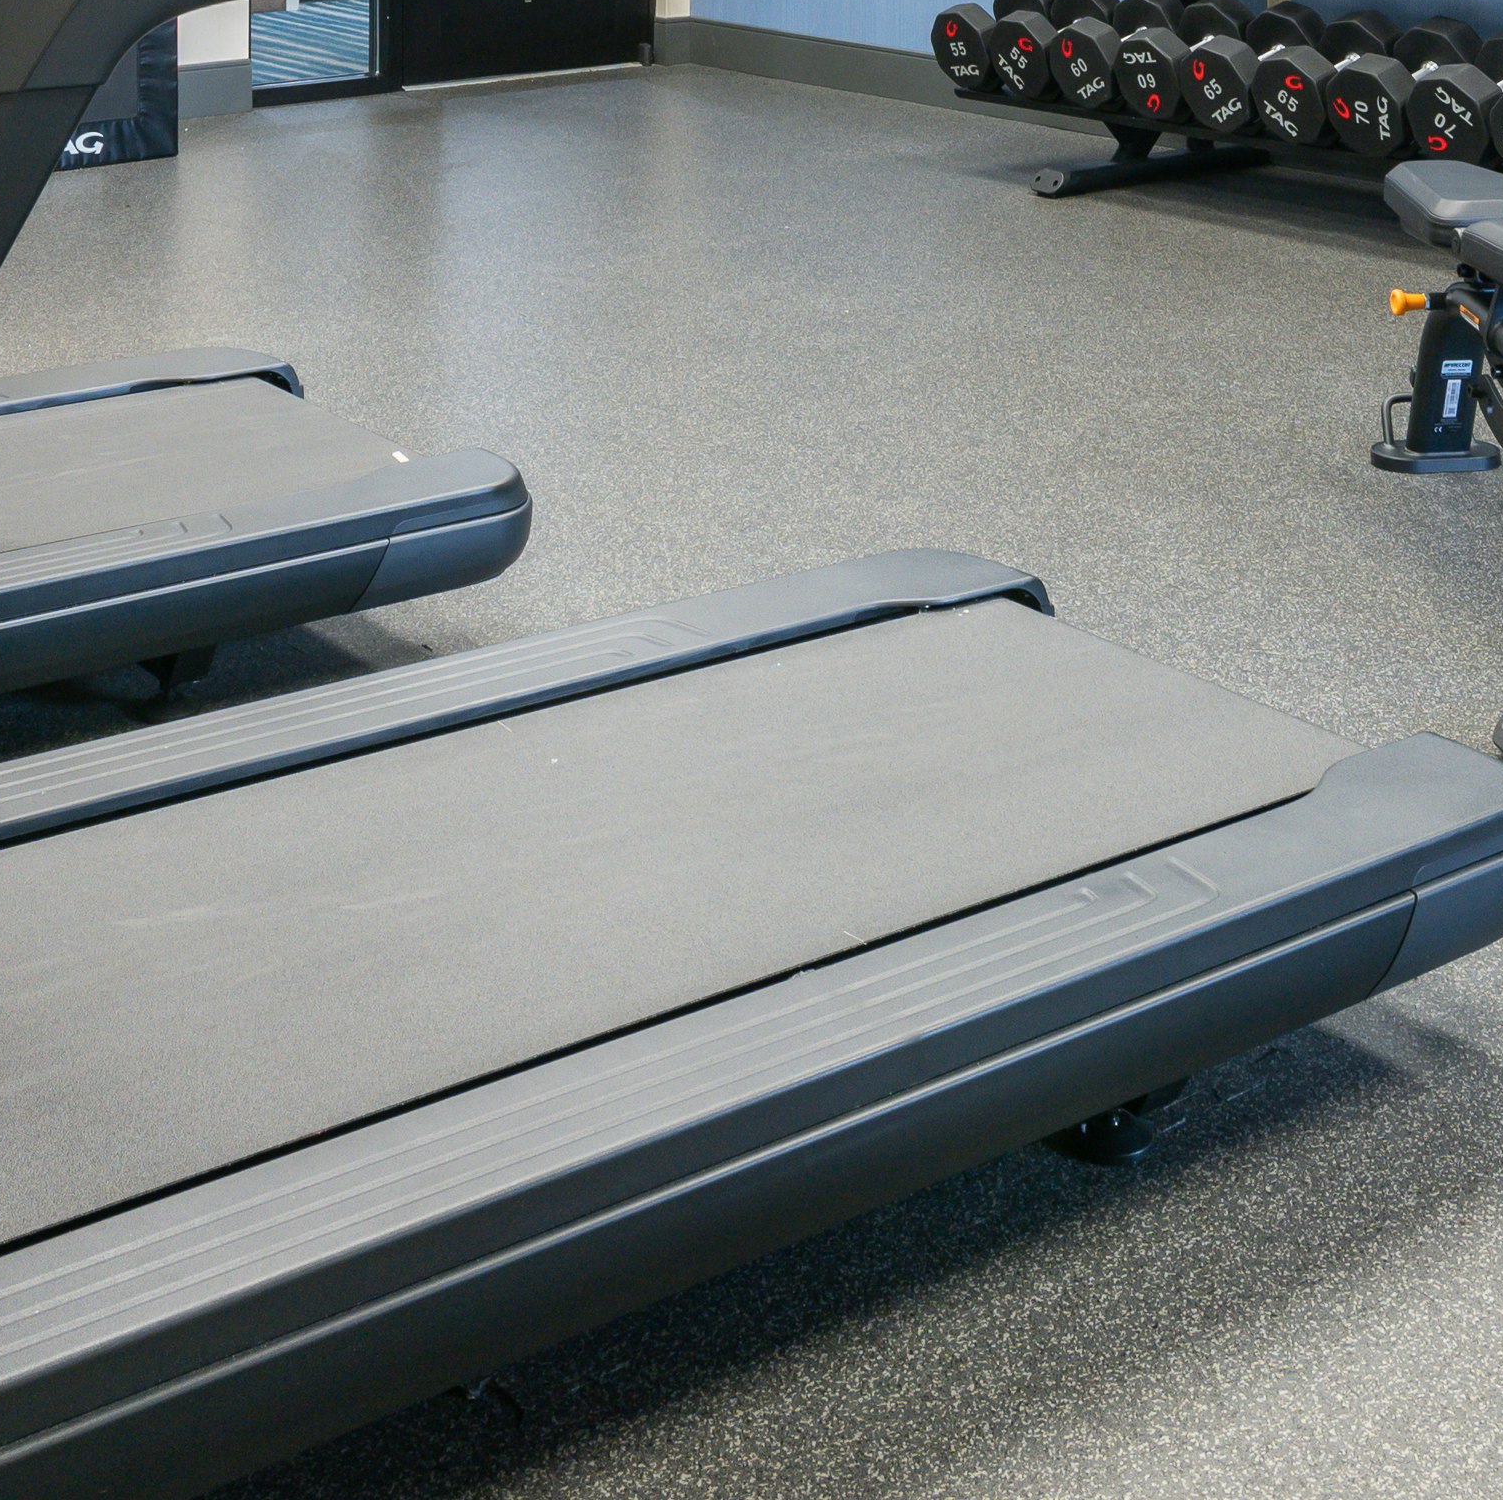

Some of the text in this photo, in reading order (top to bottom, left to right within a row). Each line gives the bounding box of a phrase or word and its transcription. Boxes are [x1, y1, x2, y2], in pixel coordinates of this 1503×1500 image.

[950, 42, 966, 56] 55
[1010, 47, 1028, 69] 55
[1123, 52, 1156, 64] TAG
[951, 65, 979, 76] TAG
[998, 54, 1025, 90] TAG
[1071, 58, 1088, 77] 60
[1077, 77, 1105, 100] TAG
[1138, 74, 1156, 89] 60
[1204, 78, 1222, 99] 65
[1212, 98, 1242, 124] TAG
[1278, 90, 1298, 112] 65
[1354, 101, 1369, 124] 70
[1435, 87, 1474, 128] TAG
[1263, 100, 1298, 137] TAG
[1377, 95, 1390, 140] TAG
[1434, 113, 1456, 139] 70
[63, 131, 104, 155] AG
